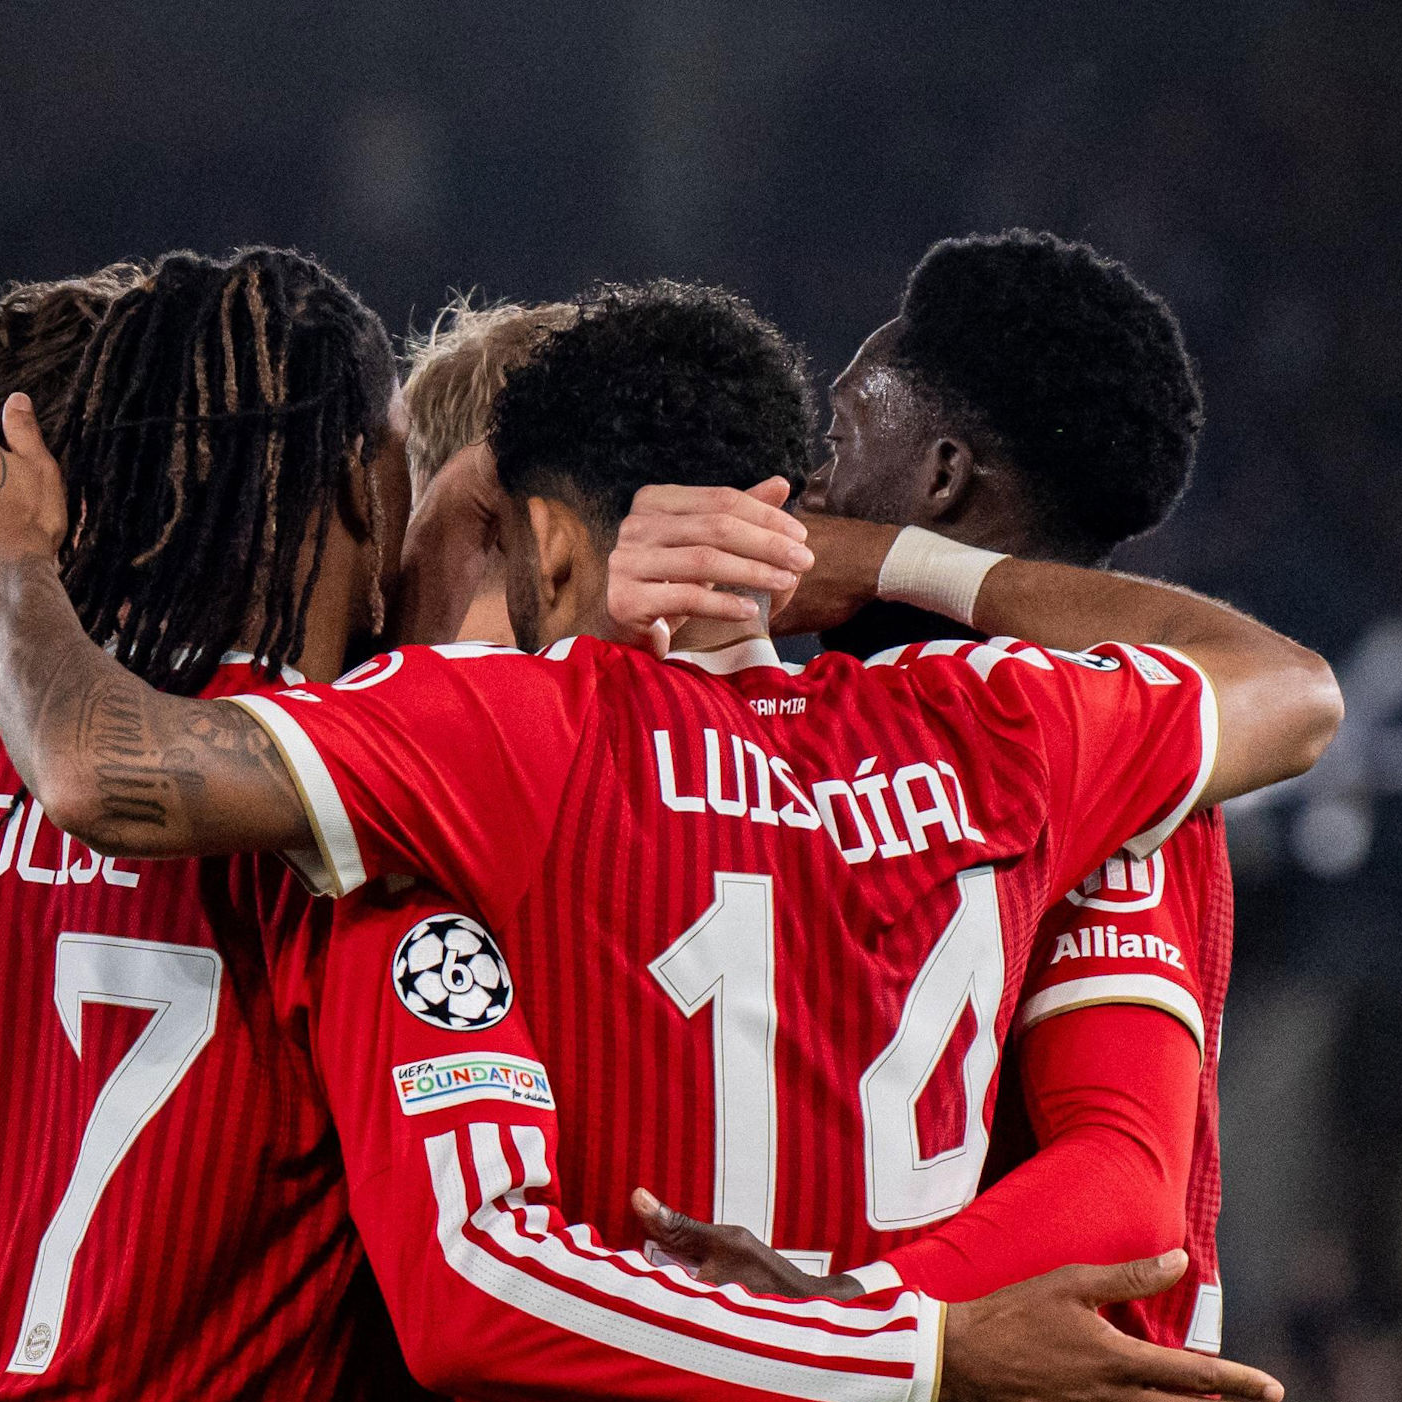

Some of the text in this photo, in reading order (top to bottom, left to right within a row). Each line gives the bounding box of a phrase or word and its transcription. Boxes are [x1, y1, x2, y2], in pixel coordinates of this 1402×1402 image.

[779, 697, 806, 715] MIA
[654, 728, 986, 865] LUIS DÍAZ
[1050, 925, 1185, 971] Allianz
[441, 949, 474, 994] 6
[398, 1062, 434, 1080] UEFA
[400, 1066, 549, 1097] FOUNDATION
[645, 865, 1005, 1278] 14
[512, 1088, 522, 1099] for
